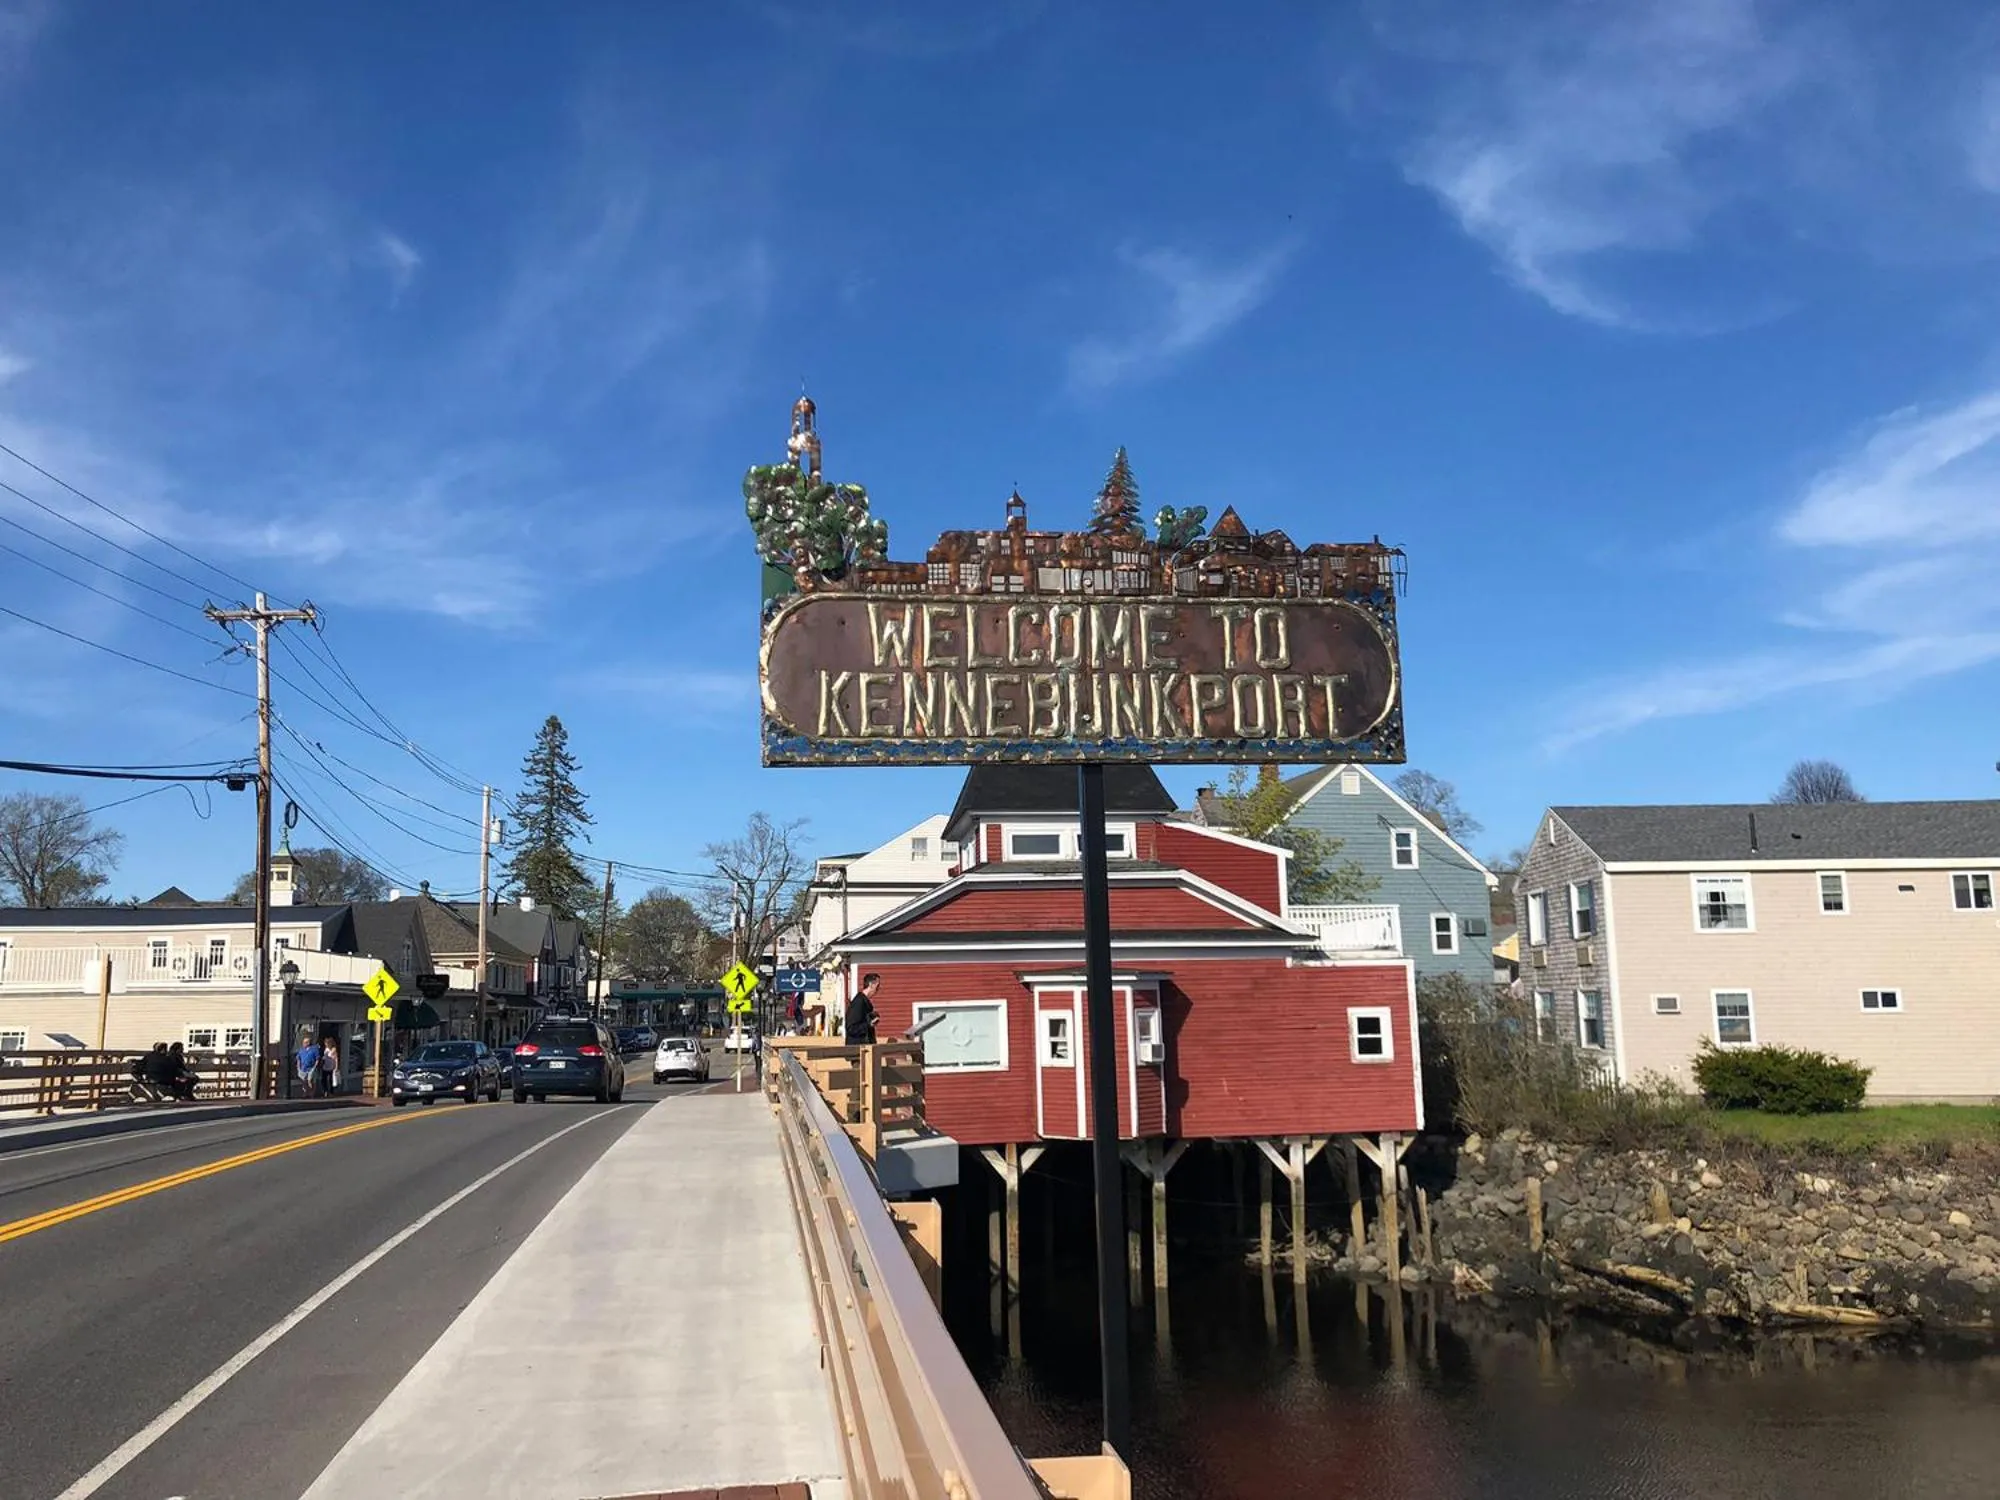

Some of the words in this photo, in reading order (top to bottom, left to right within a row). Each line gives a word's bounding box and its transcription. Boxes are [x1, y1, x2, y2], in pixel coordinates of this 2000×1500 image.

[867, 603, 1178, 669] WELCOME
[1211, 605, 1291, 669] TO
[818, 670, 1349, 738] KENNEBUNKPORT
